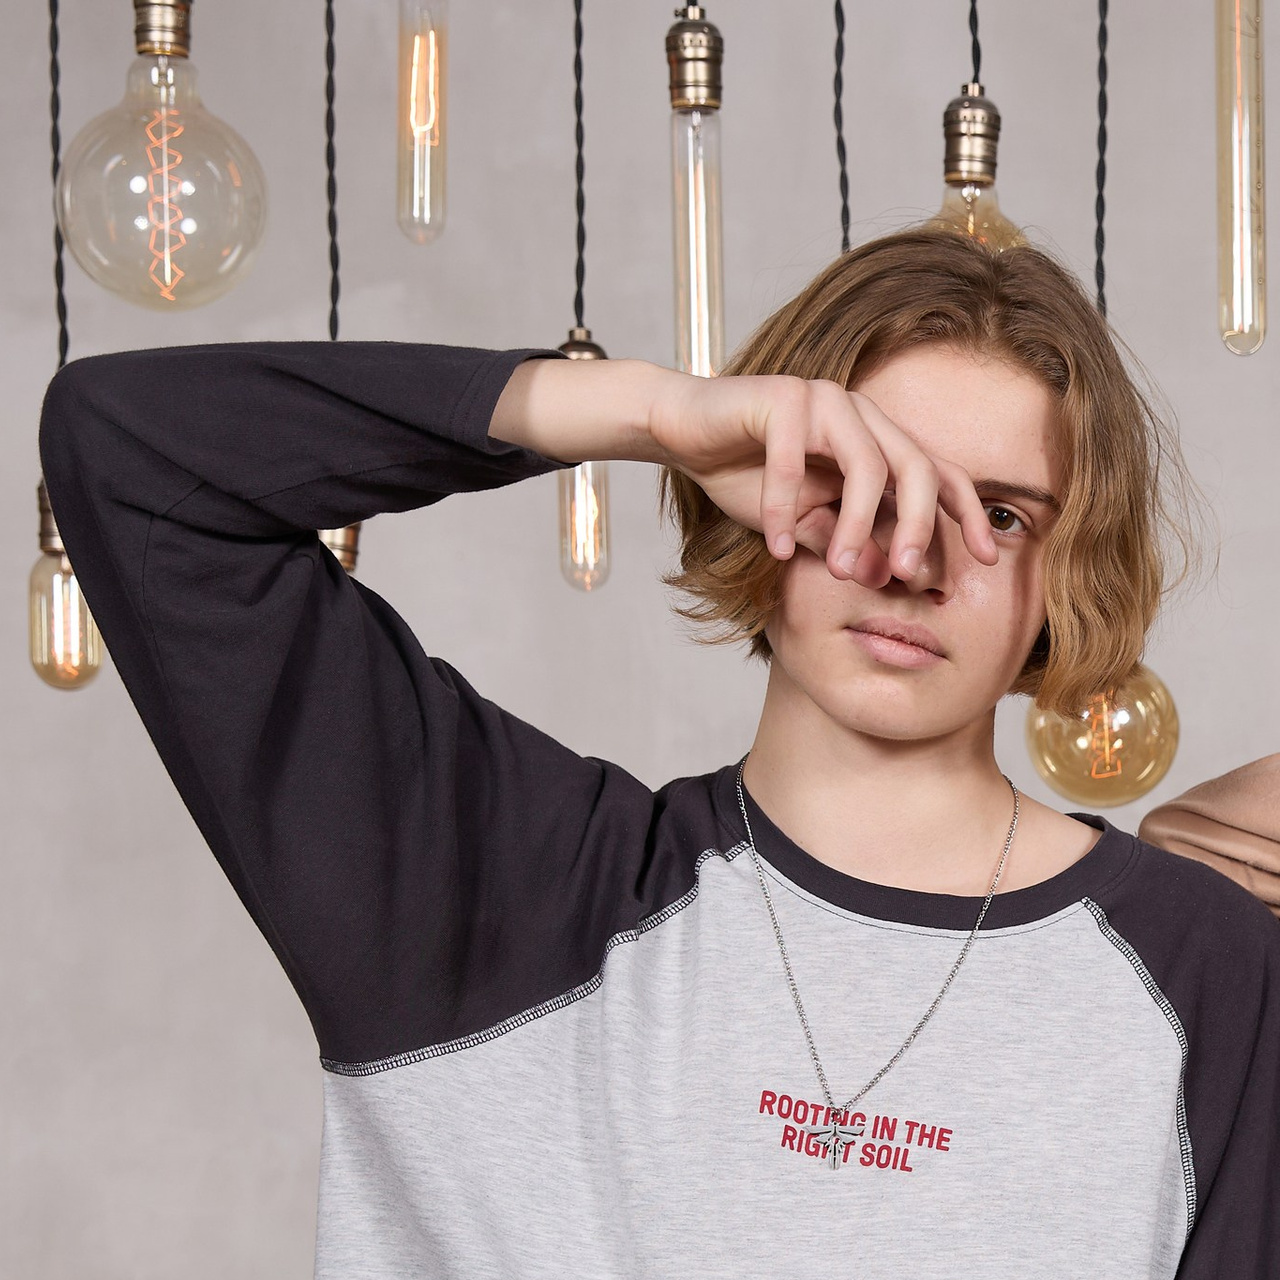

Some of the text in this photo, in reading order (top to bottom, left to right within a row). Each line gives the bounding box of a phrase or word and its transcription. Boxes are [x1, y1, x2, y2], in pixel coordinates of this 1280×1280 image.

[871, 1115, 898, 1142] IN
[904, 1120, 953, 1152] THE
[859, 1142, 913, 1173] SOIL
